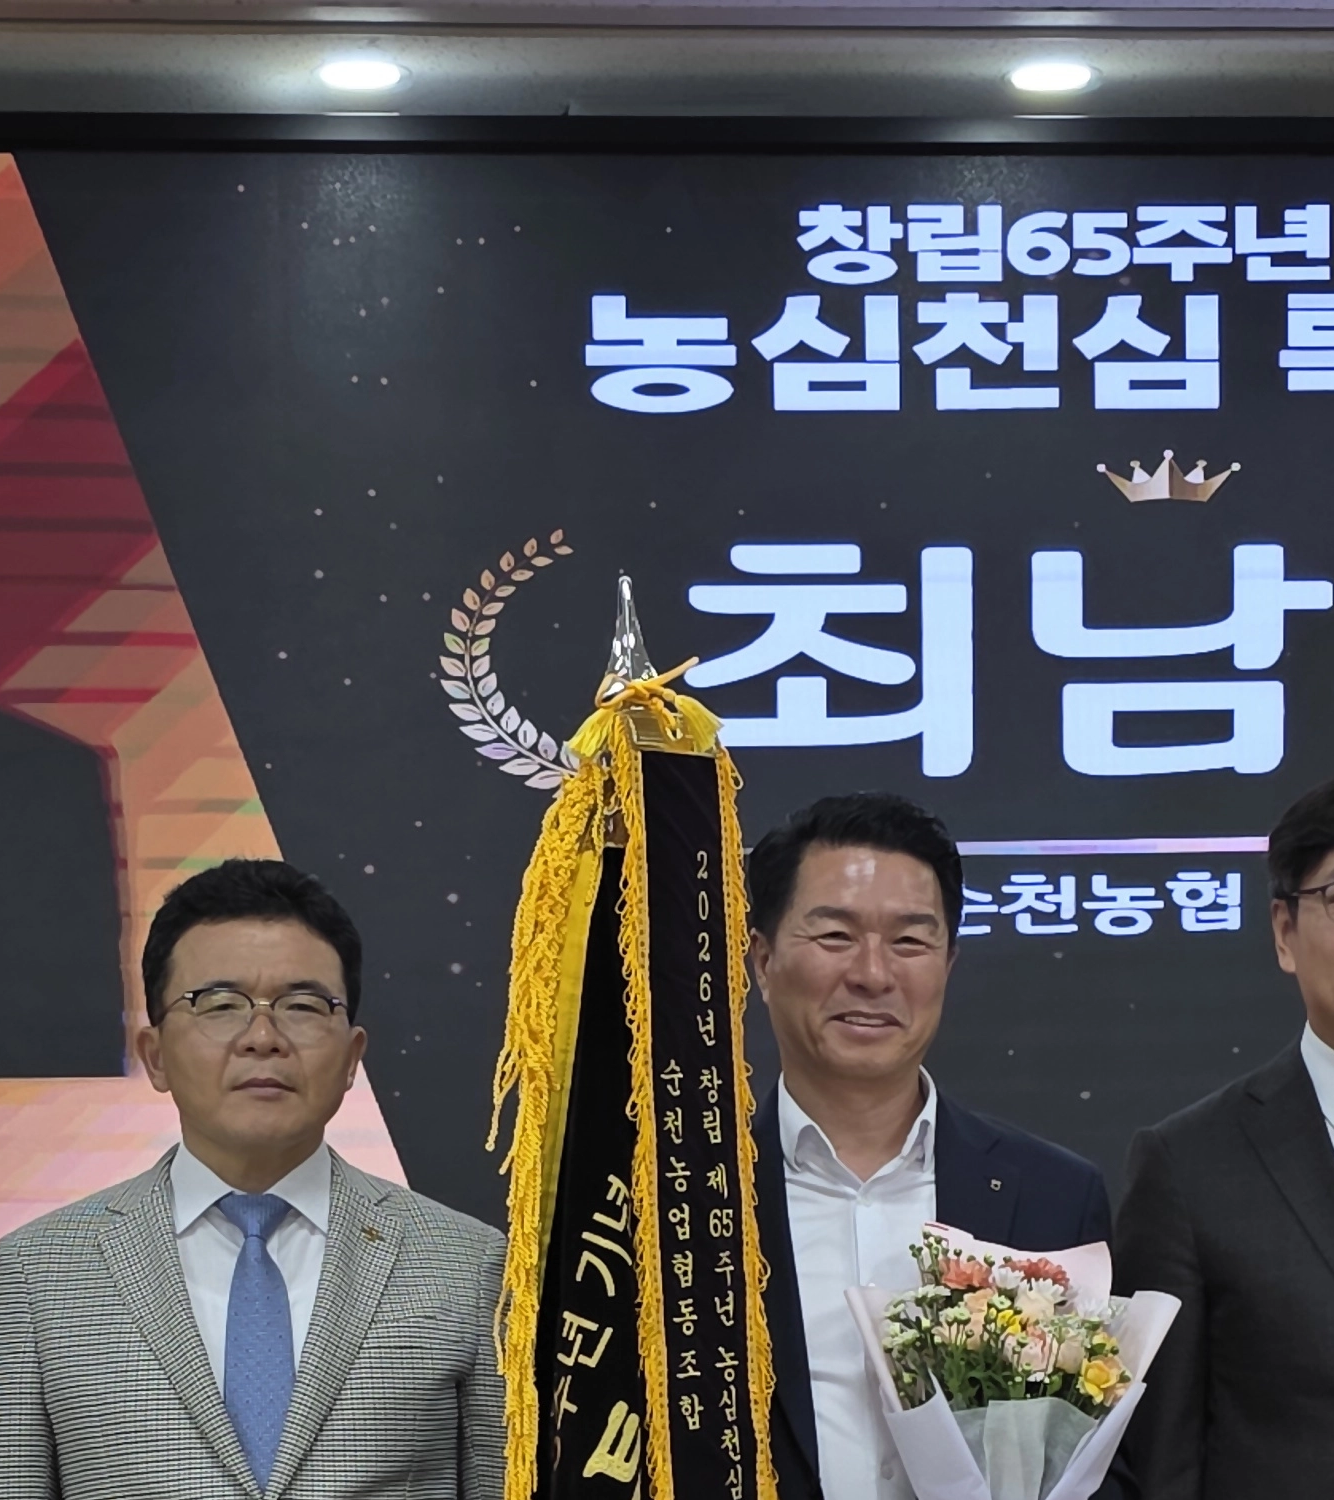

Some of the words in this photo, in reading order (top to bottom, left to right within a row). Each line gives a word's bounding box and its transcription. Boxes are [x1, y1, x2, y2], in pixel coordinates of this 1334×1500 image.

[795, 203, 1333, 286] 창립65주년
[584, 291, 1221, 414] 농심천심
[695, 849, 717, 1048] 2026년
[698, 1064, 724, 1145] 창립
[659, 1058, 702, 1431] 순천농업협동조합
[705, 1161, 736, 1328] 제65주년
